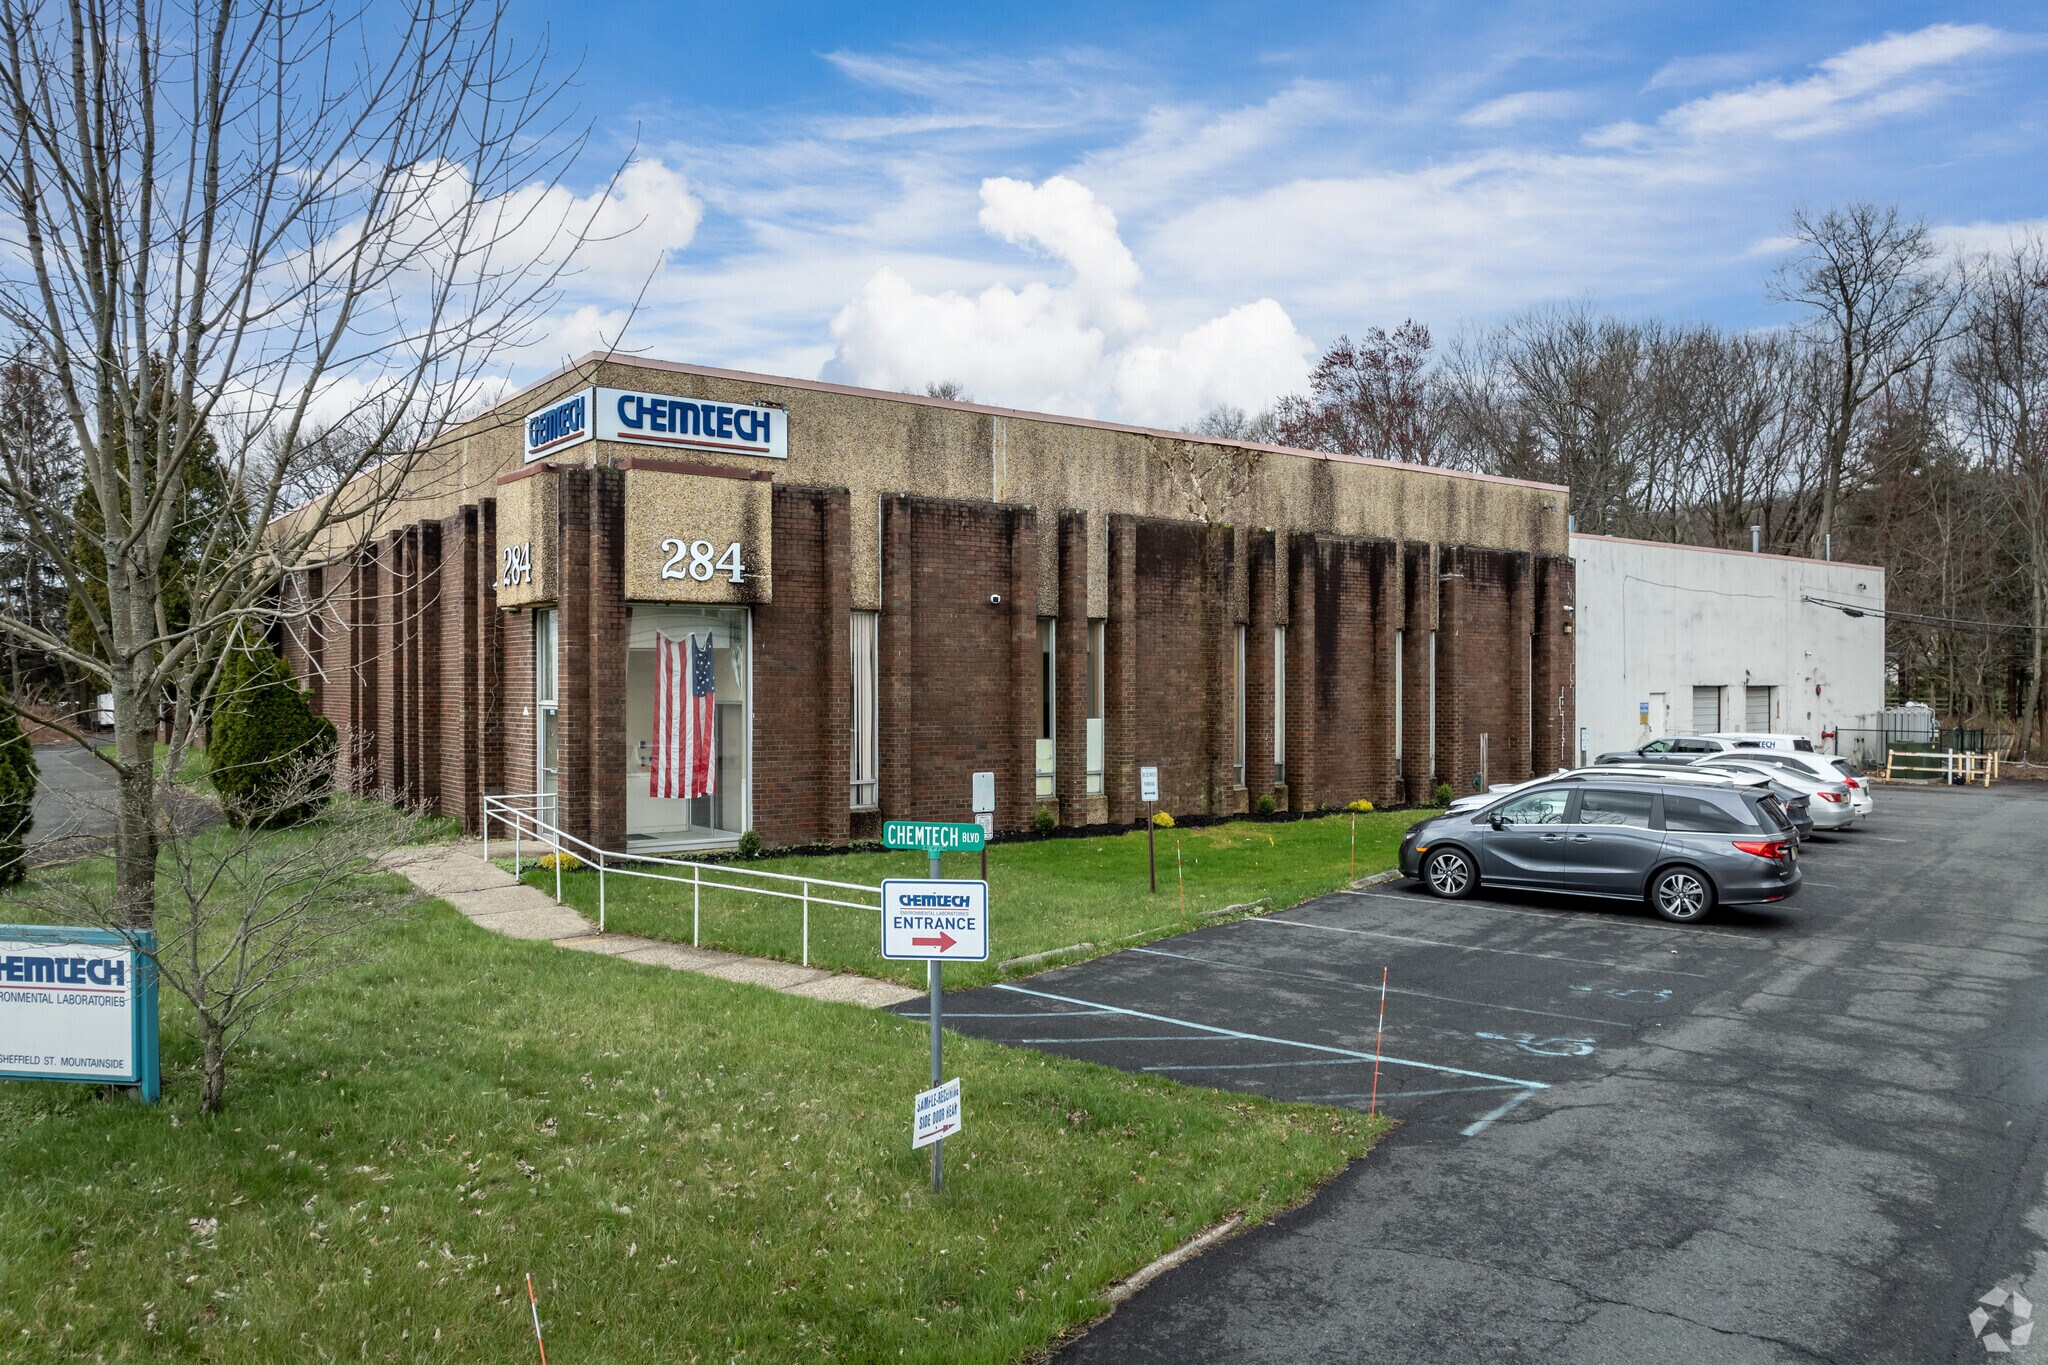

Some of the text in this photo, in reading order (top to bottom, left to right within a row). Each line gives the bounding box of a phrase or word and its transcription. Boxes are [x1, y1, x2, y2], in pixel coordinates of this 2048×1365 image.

[529, 396, 586, 447] CHEMTECH
[617, 395, 770, 443] CHEMTECH
[503, 541, 532, 586] 284
[661, 538, 746, 584] 284
[887, 824, 959, 847] CHEMTECH
[962, 832, 980, 844] BLVD
[899, 894, 970, 908] CHEMTECH
[894, 916, 976, 930] ENTRANCE
[57, 994, 125, 1008] LABORATORIES
[44, 1056, 57, 1066] ST.
[60, 1057, 124, 1069] MOUNTAINSIDE
[919, 1113, 931, 1130] SIDE
[932, 1108, 945, 1125] DOOR
